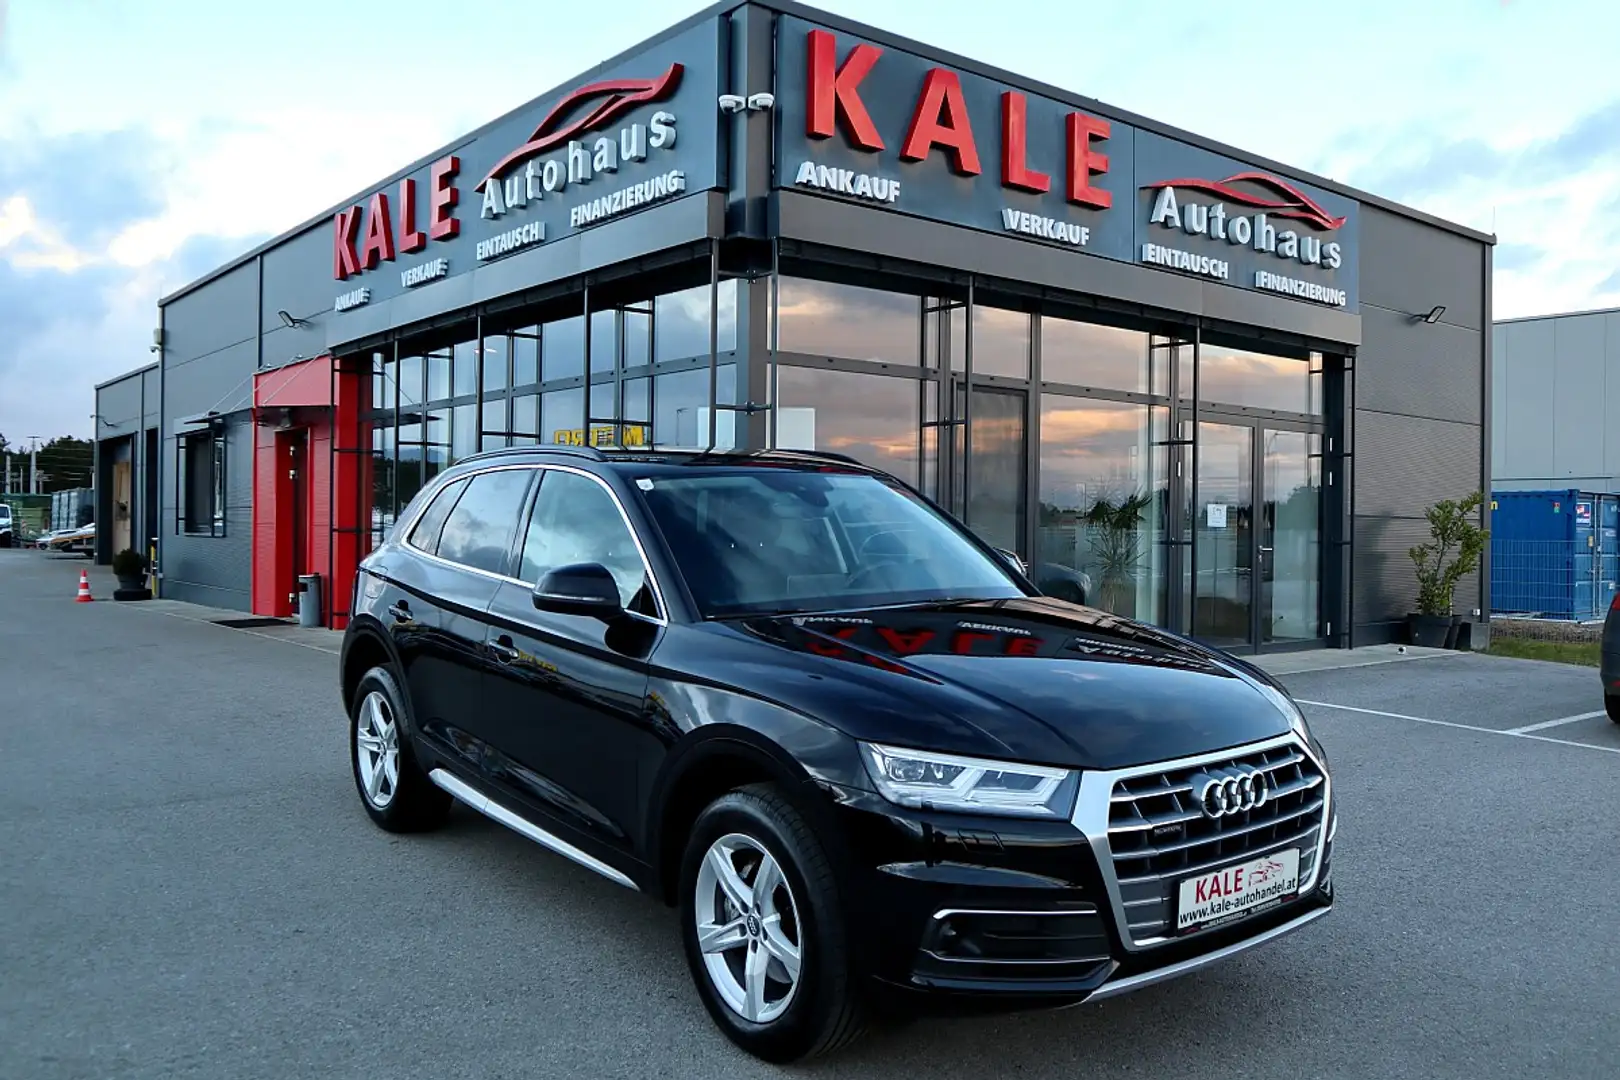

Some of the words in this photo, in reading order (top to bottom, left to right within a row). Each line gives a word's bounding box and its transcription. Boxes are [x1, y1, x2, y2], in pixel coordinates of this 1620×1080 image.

[806, 29, 1112, 210] KALE
[481, 111, 676, 219] Autohaus
[795, 161, 900, 203] ANKAUF
[334, 156, 460, 280] KALE
[571, 170, 685, 227] FINANZIERUNG
[476, 222, 546, 260] EINTAUSCH
[1001, 208, 1090, 245] VERKAUF
[1150, 186, 1341, 269] Autohaus
[401, 258, 448, 287] VERKAUF
[1142, 243, 1229, 279] EINTAUSCH
[335, 288, 370, 311] ANKAUF
[1255, 270, 1346, 306] FINANZIERUNG
[1179, 877, 1296, 924] www.kale-autohandel.at
[1195, 868, 1244, 904] KALE
